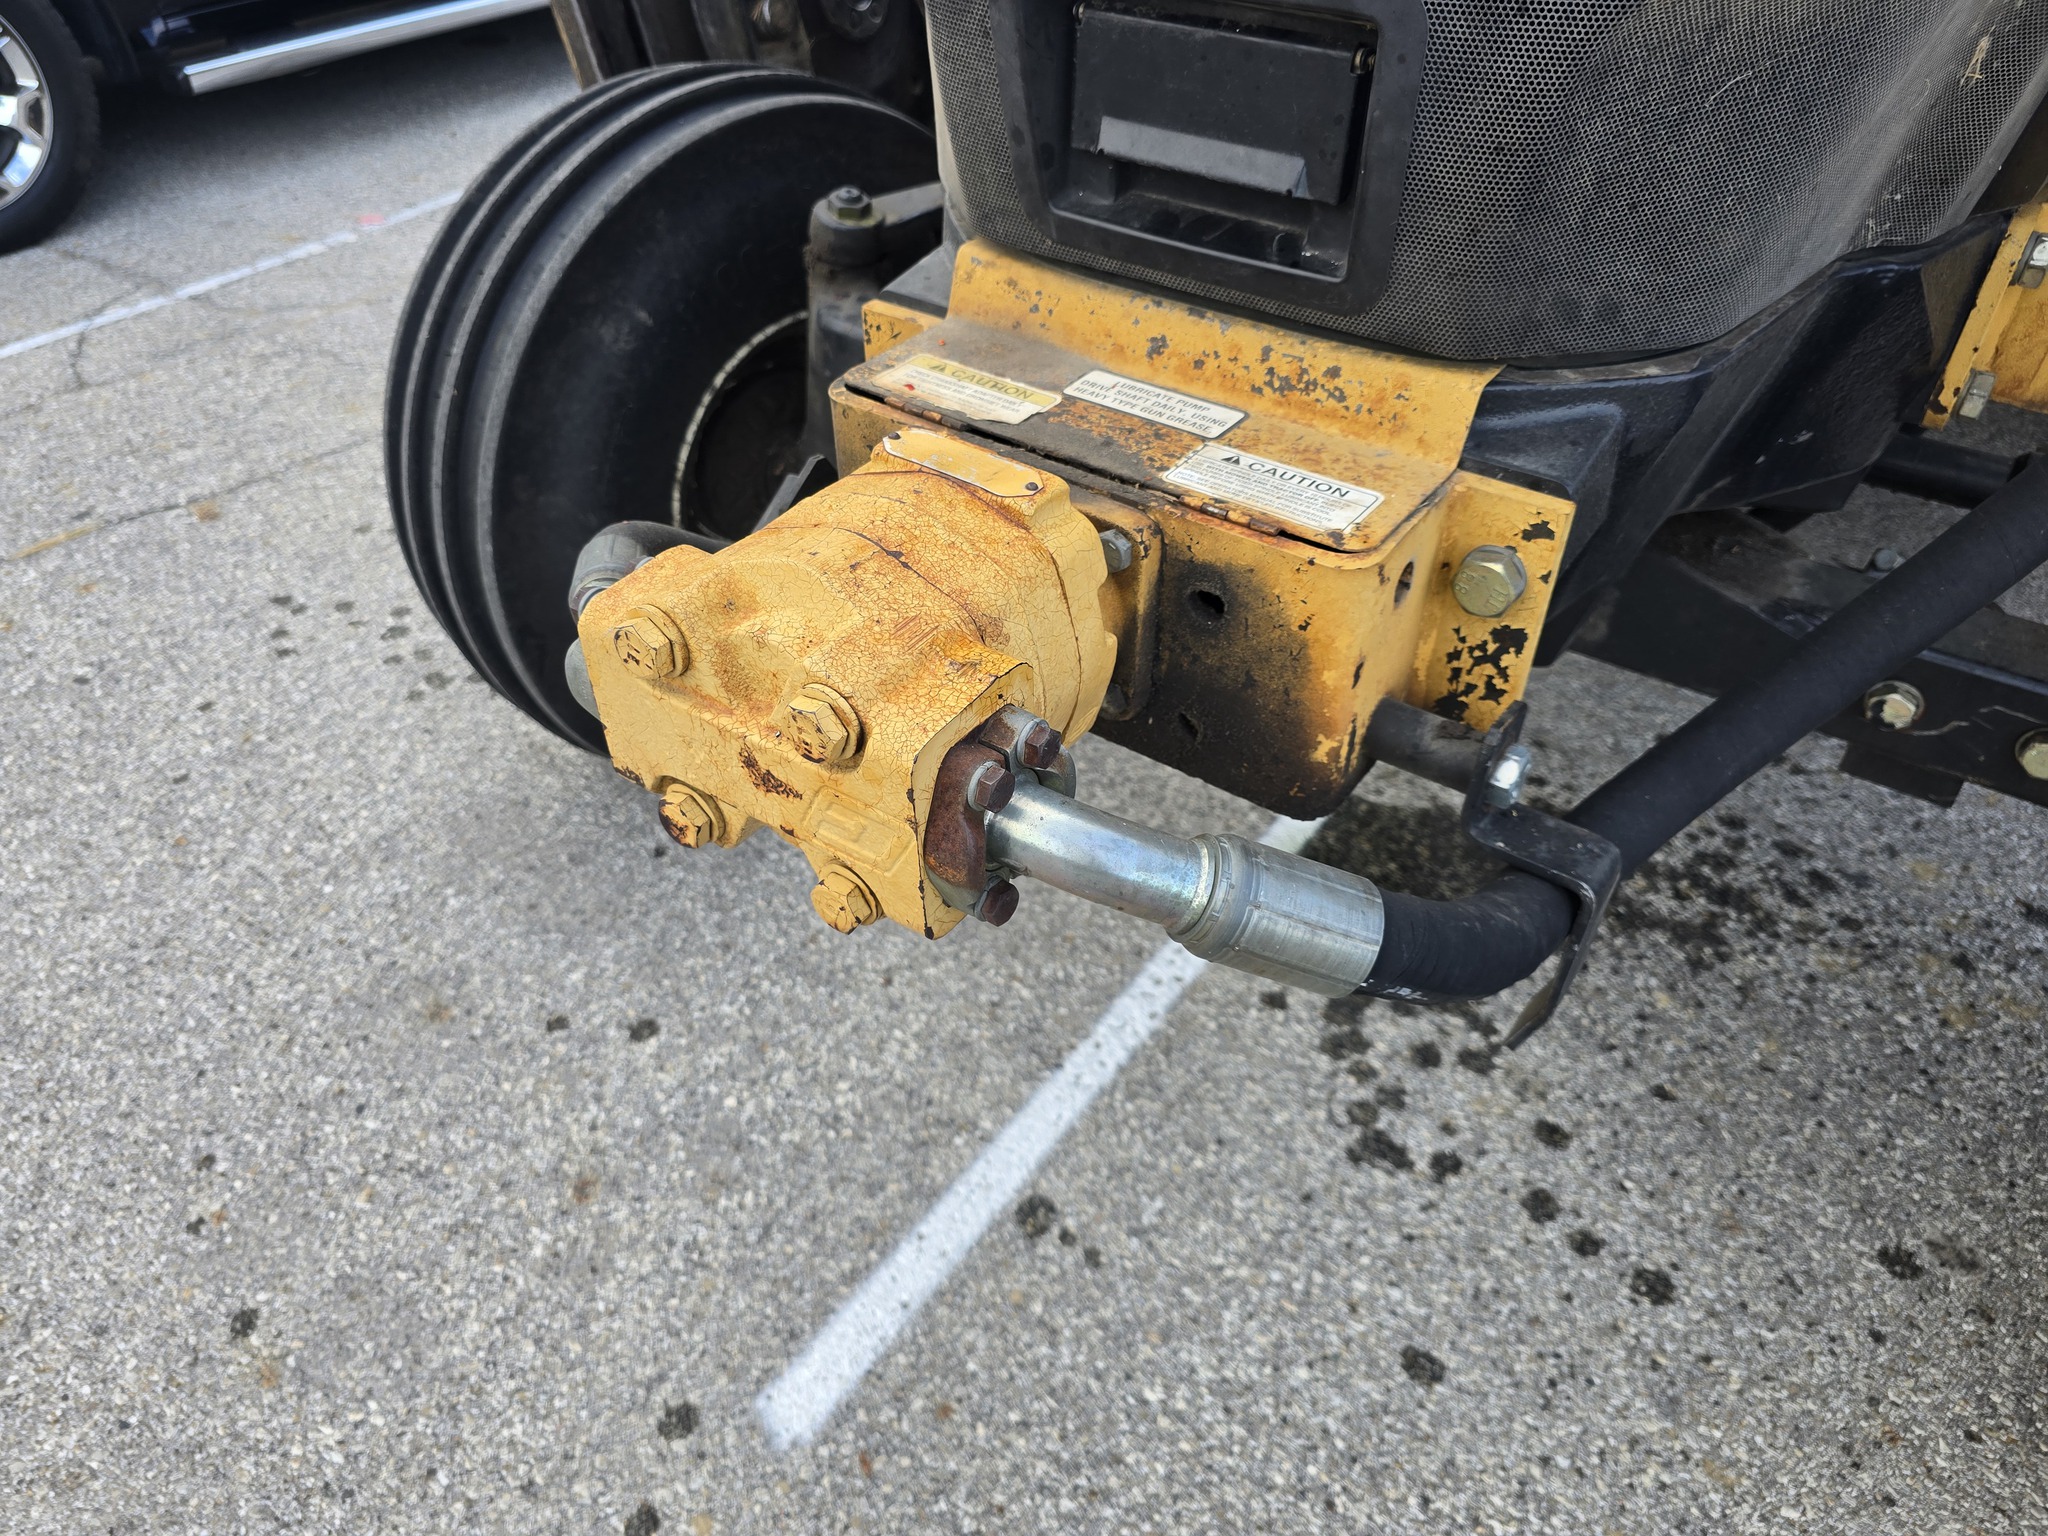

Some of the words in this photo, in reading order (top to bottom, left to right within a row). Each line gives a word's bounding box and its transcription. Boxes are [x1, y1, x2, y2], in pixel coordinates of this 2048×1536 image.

[949, 369, 1036, 400] CAUTION
[1112, 381, 1176, 402] LUBRICATE
[1173, 399, 1211, 413] PUMP
[1072, 386, 1109, 400] HEAVY
[1108, 397, 1140, 409] TYPE
[1137, 406, 1167, 418] GUN
[1079, 379, 1114, 392] DRIVE
[1112, 389, 1151, 404] SHAFT
[1189, 412, 1228, 427] USING
[1223, 470, 1253, 481] MOWER
[1268, 484, 1304, 497] TRACTOR
[1247, 461, 1352, 498] CAUTION
